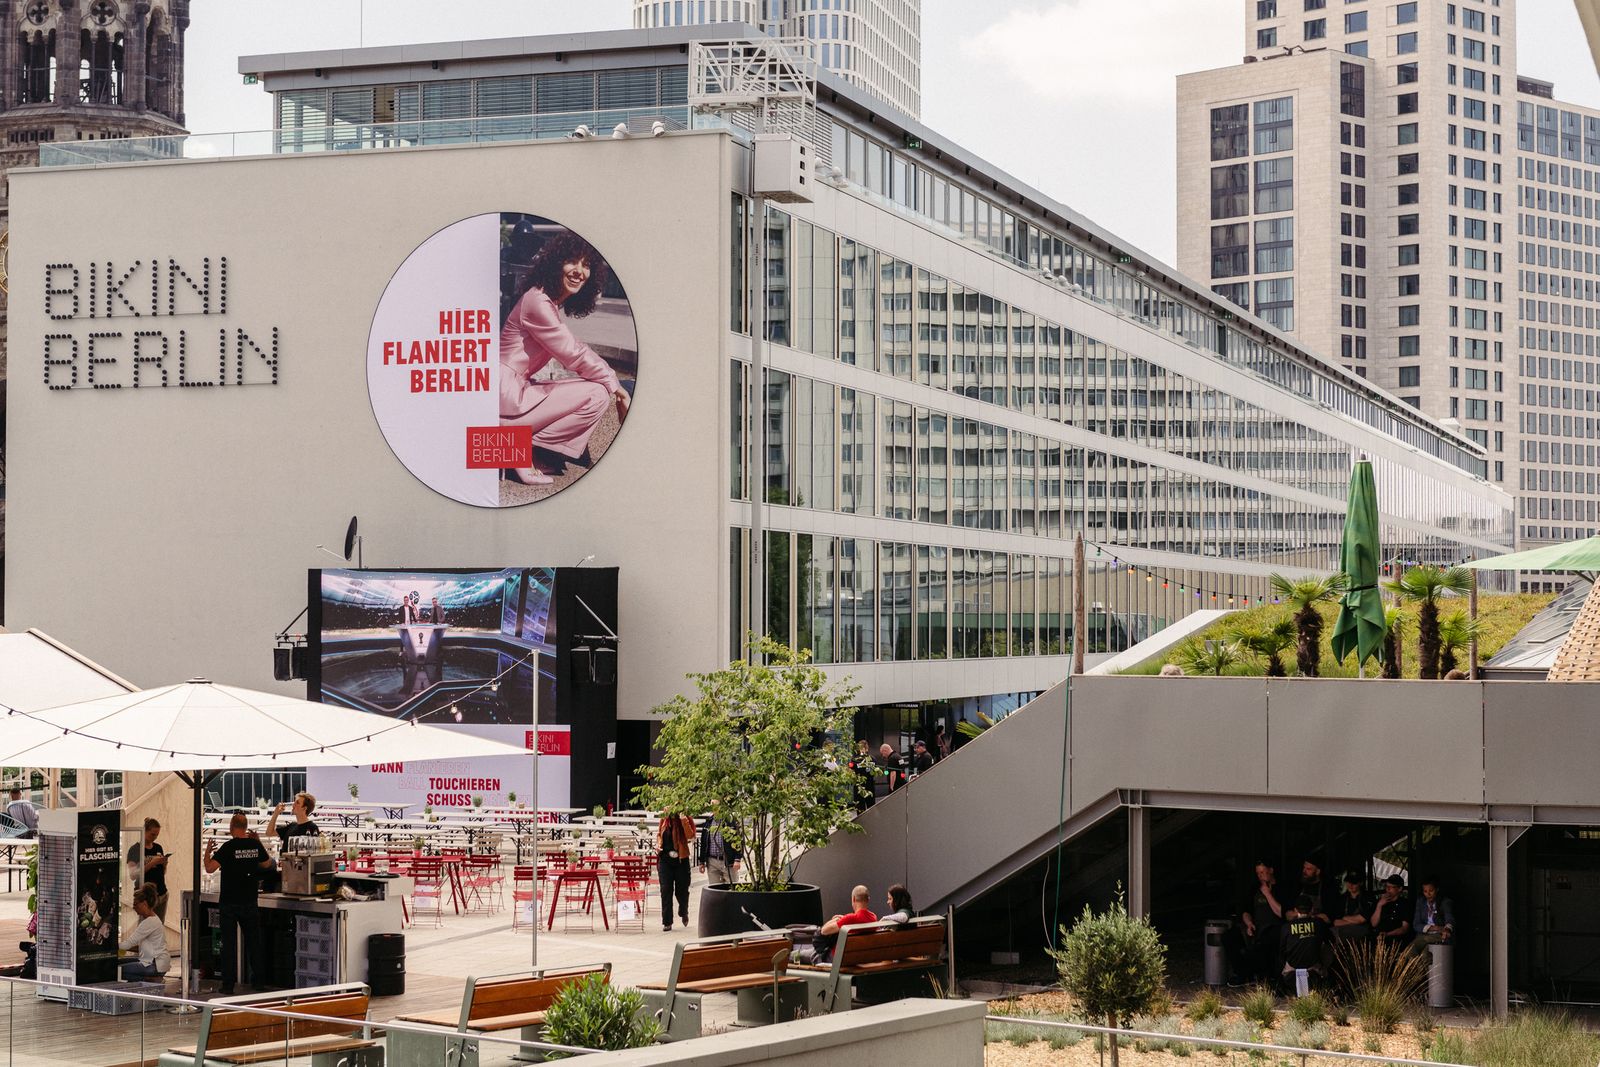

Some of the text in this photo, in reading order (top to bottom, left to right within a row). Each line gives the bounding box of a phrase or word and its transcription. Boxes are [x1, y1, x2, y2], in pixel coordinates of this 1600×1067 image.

[45, 256, 228, 320] BIKINI
[439, 308, 491, 335] HIER
[44, 327, 278, 390] BERLIN
[383, 338, 491, 365] FLANIERT
[410, 366, 490, 393] BERLIN
[472, 432, 515, 447] BIKINI
[472, 447, 526, 463] BERLIN
[528, 734, 554, 743] BKINI
[528, 743, 561, 752] BRLIN
[371, 761, 404, 773] DANN
[428, 777, 501, 791] TOUCHIEREN
[426, 793, 472, 806] SCHUSS
[1290, 922, 1315, 935] NENI
